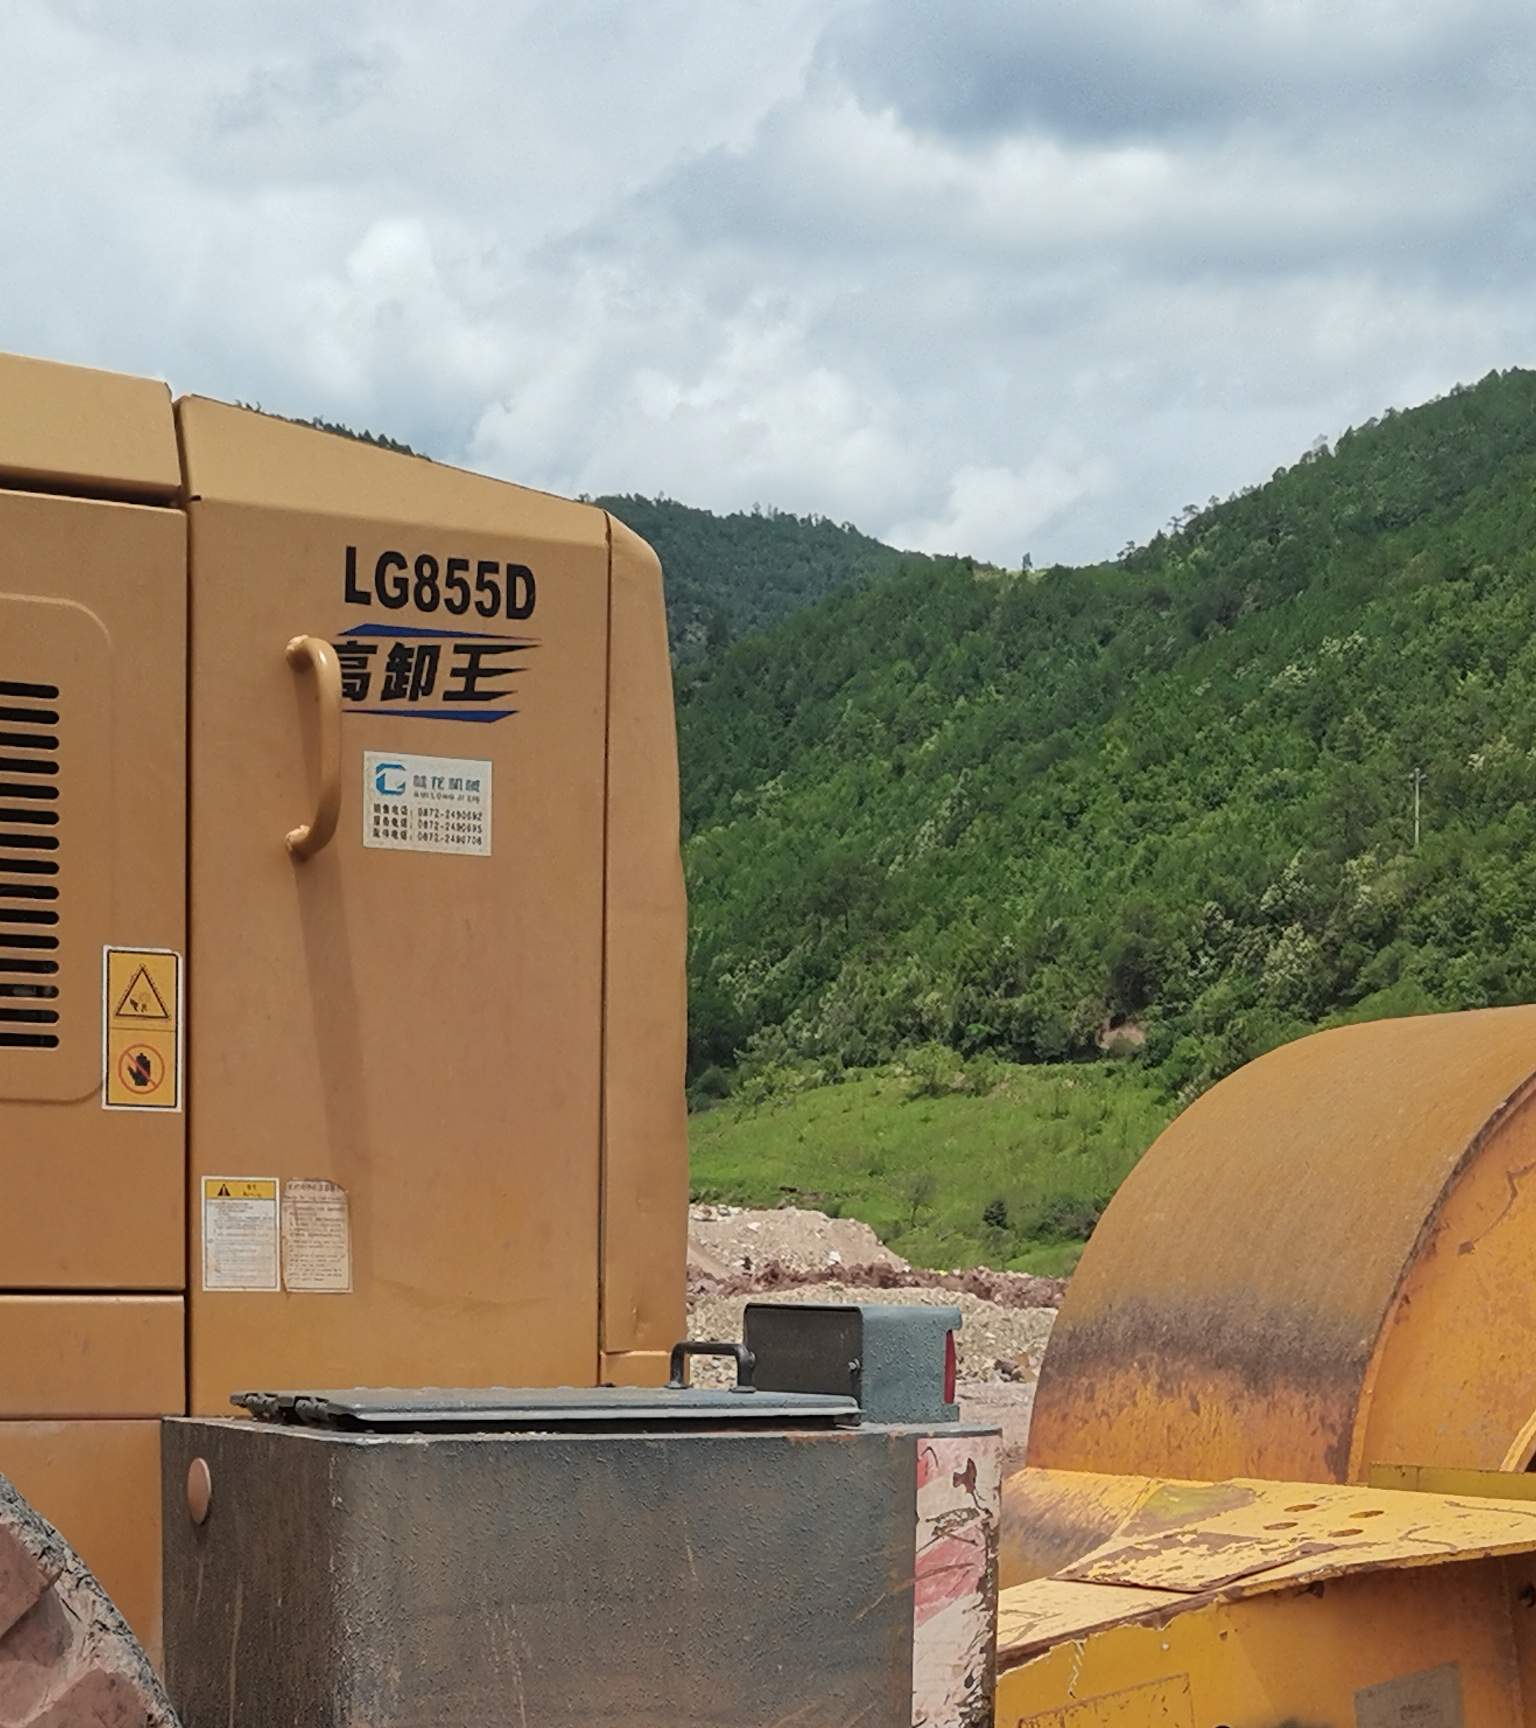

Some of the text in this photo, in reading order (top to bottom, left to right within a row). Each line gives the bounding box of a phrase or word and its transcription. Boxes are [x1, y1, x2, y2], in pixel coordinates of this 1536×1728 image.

[343, 545, 537, 621] LG855D
[332, 640, 544, 703] 高卸王
